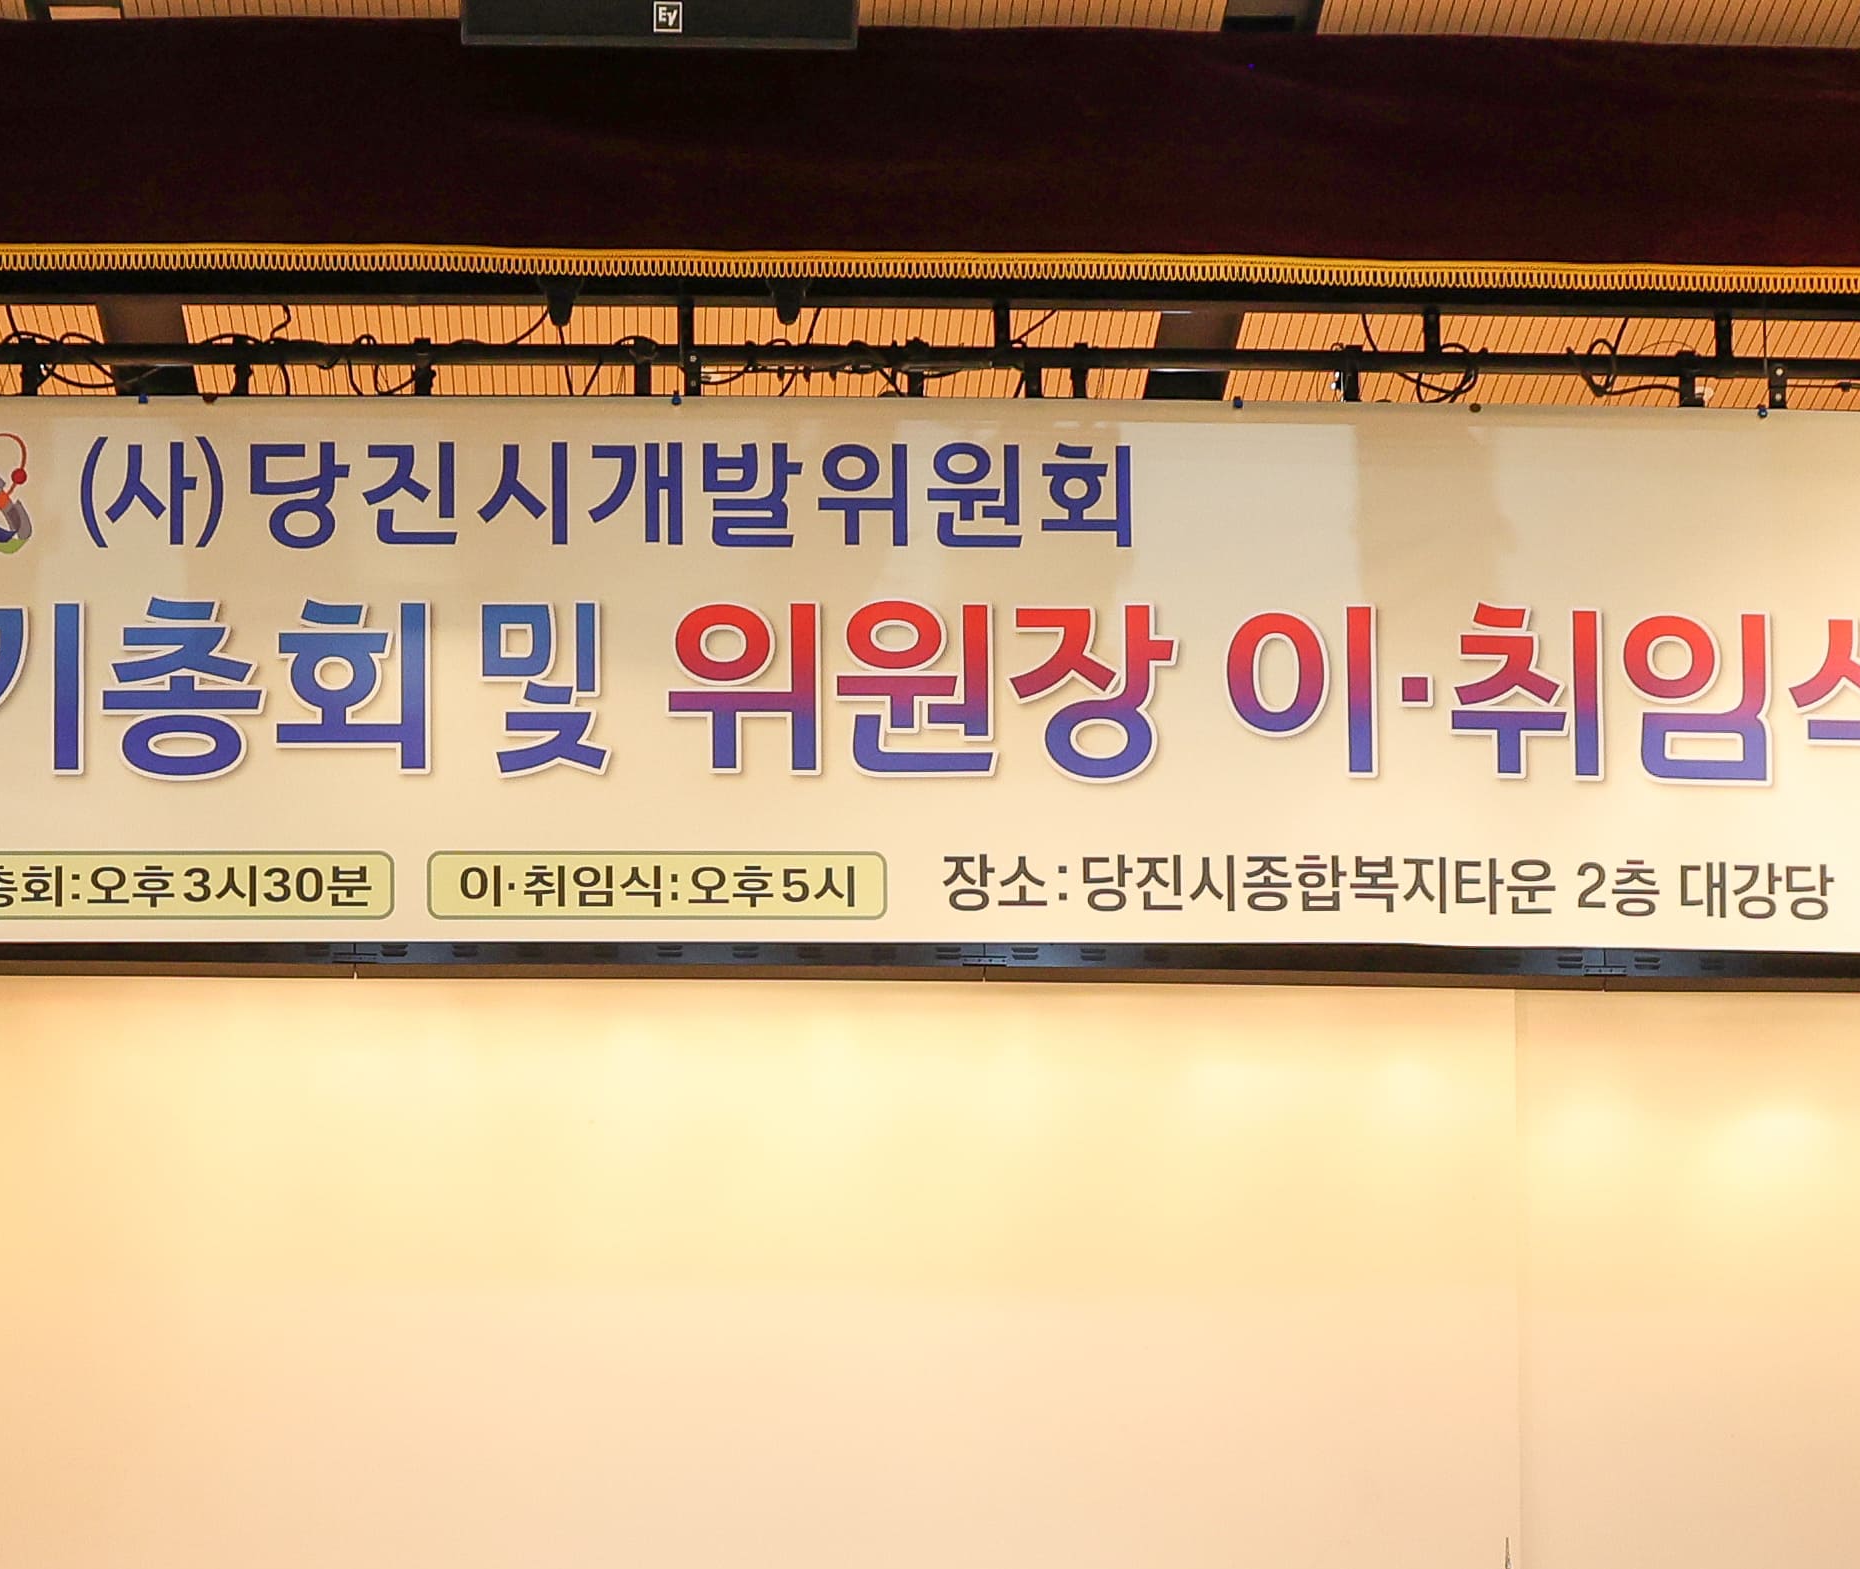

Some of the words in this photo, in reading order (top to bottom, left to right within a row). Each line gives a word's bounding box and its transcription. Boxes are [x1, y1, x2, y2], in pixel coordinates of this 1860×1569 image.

[479, 600, 613, 779] 및
[666, 599, 1178, 783] 위원장
[1575, 860, 1662, 918] 2층
[1680, 862, 1835, 922] 대강당
